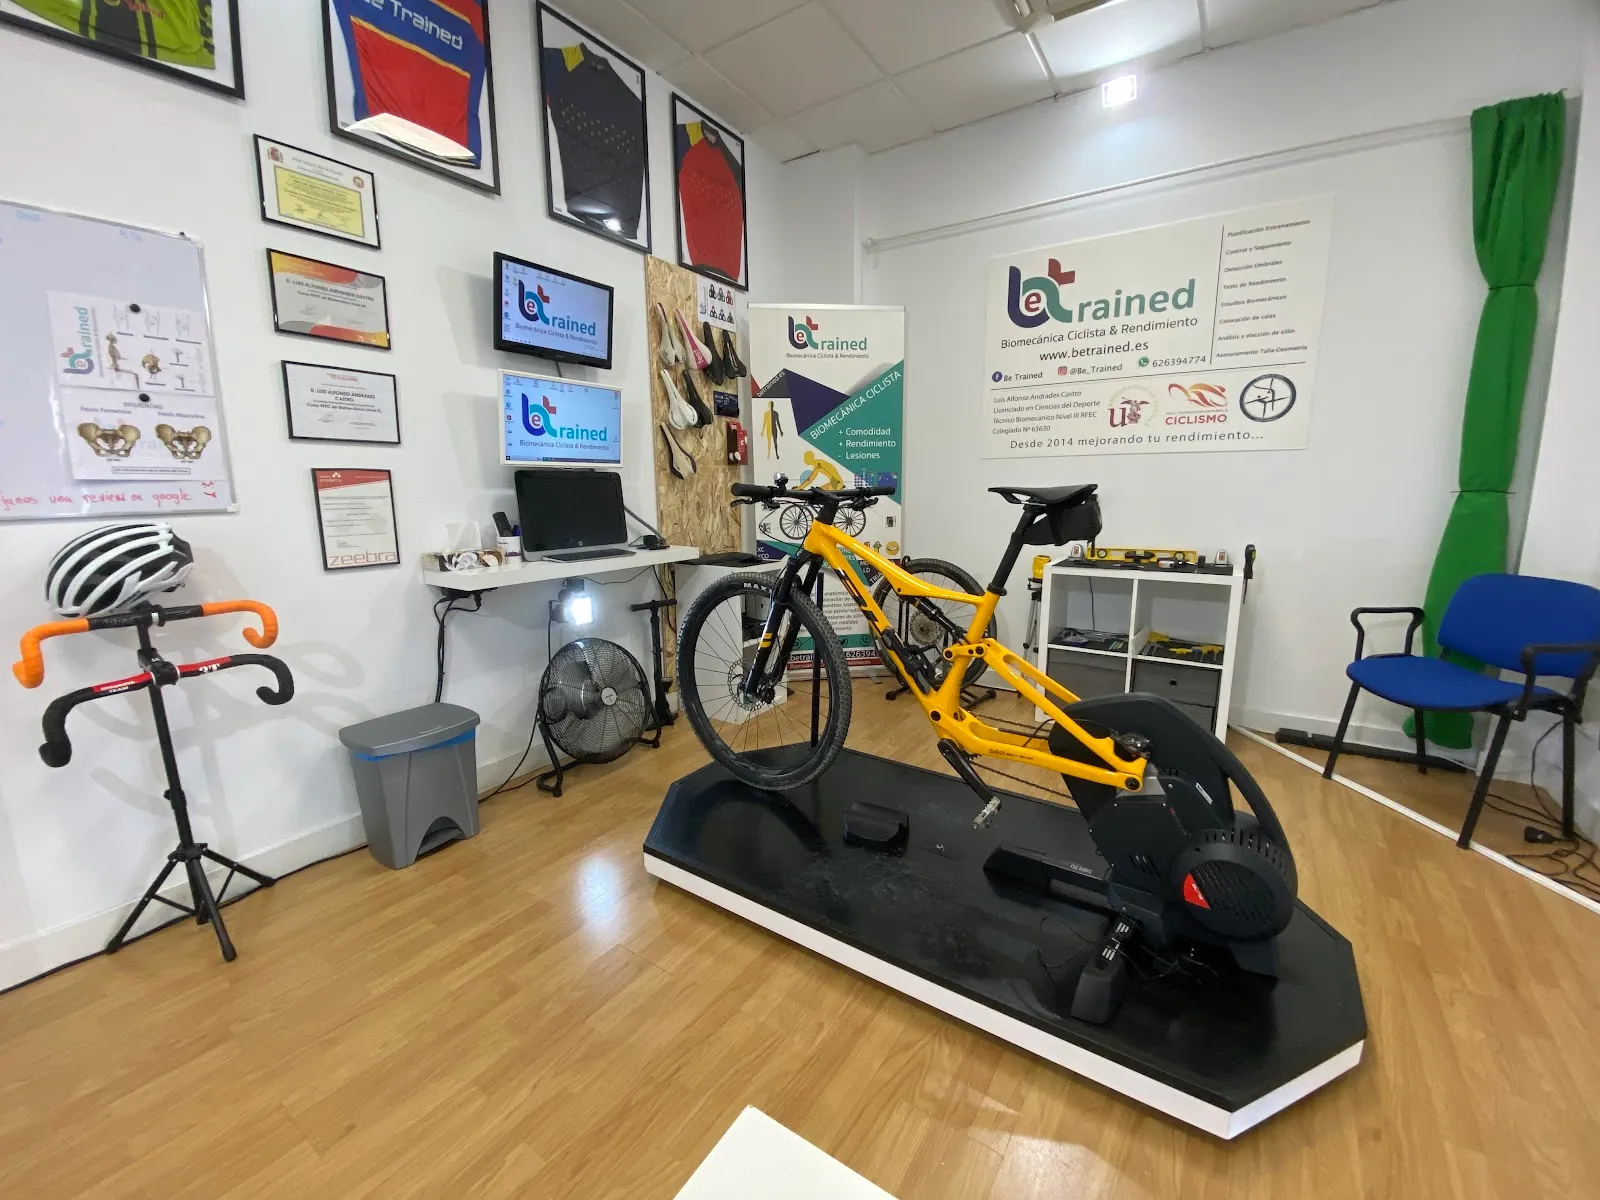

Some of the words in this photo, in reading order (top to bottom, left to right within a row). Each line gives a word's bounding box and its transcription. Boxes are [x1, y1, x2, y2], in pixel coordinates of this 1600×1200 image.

[361, 0, 384, 10] e
[390, 0, 463, 50] Trained
[1226, 247, 1247, 255] Control
[1248, 277, 1286, 287] Rendimiento
[1220, 316, 1250, 324] Colocación
[1001, 334, 1064, 349] Biomecánica
[1068, 328, 1105, 340] Ciclista
[1110, 326, 1118, 335] &
[1122, 317, 1198, 334] Rendimiento
[1040, 341, 1149, 361] www.betrained.es
[1216, 349, 1258, 358] Asesoramiento
[1152, 356, 1206, 368] 626394774
[1004, 374, 1012, 382] Be
[1015, 371, 1043, 381] Trained
[994, 396, 1005, 404] Luis
[1007, 394, 1028, 402] Alfonso
[1030, 392, 1059, 400] Andrades
[1061, 390, 1081, 398] Castro
[810, 396, 866, 440] BIOMECÁNICA
[866, 371, 902, 399] CICLISTA
[993, 405, 1025, 413] Licenciado
[1035, 402, 1060, 411] Ciencias
[1062, 401, 1072, 409] del
[1073, 400, 1100, 410] Deporte
[993, 416, 1014, 424] Técnico
[1016, 414, 1055, 423] Biomecánico
[1056, 412, 1072, 420] Nivel
[1081, 411, 1097, 419] RFEC
[1166, 414, 1227, 425] CICLISMO
[845, 427, 890, 436] Comodidad
[993, 427, 1022, 436] Colegiado
[845, 439, 896, 448] Rendimiento
[1010, 440, 1042, 449] Desde
[1047, 438, 1073, 448] 2014
[1078, 435, 1143, 449] mejorando
[1149, 435, 1161, 443] tu
[845, 452, 880, 460] Lesiones
[152, 488, 192, 507] google
[329, 550, 396, 567] zeebra
